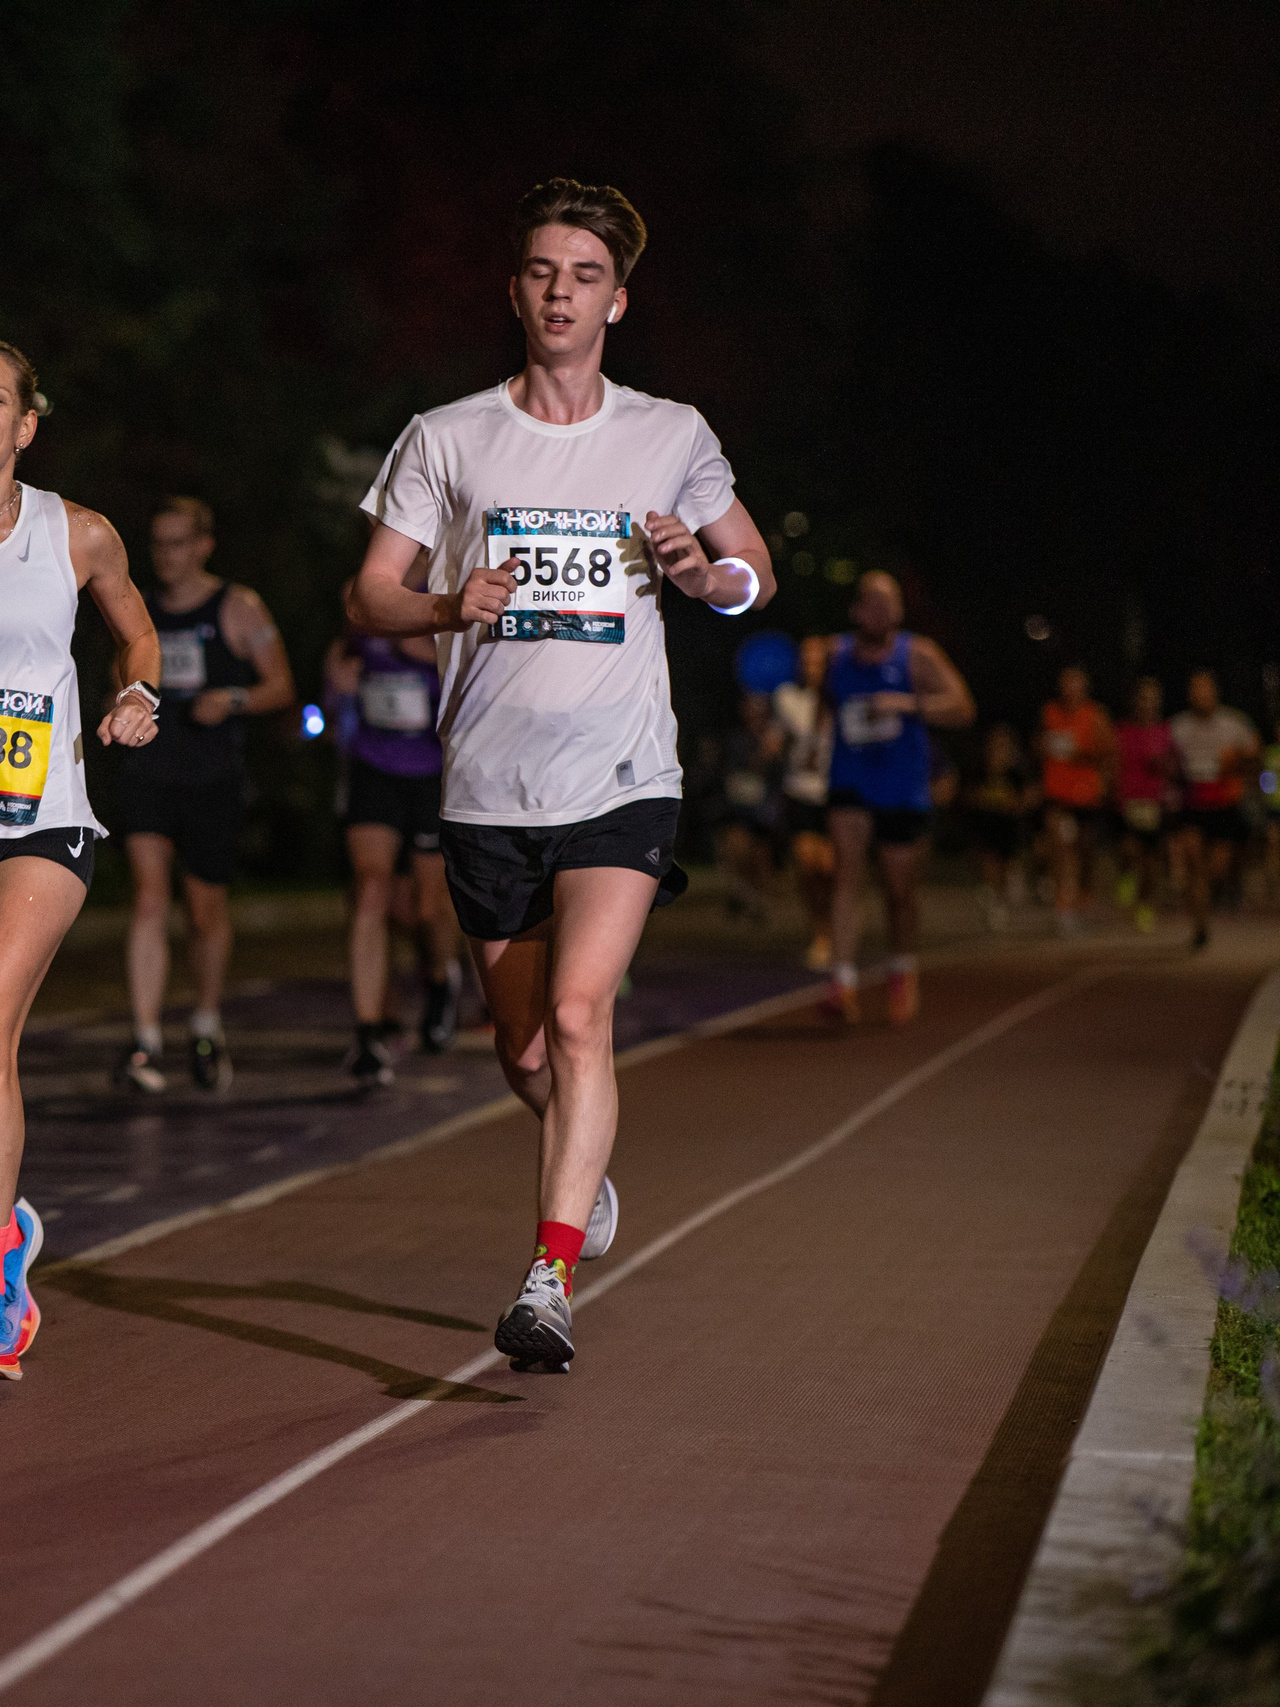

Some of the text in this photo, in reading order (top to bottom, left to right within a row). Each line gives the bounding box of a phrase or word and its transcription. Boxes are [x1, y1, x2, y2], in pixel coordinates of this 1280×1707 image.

[500, 508, 621, 532] НОЧНОЙ
[508, 547, 613, 588] 5568
[532, 590, 586, 602] ВИКТОР
